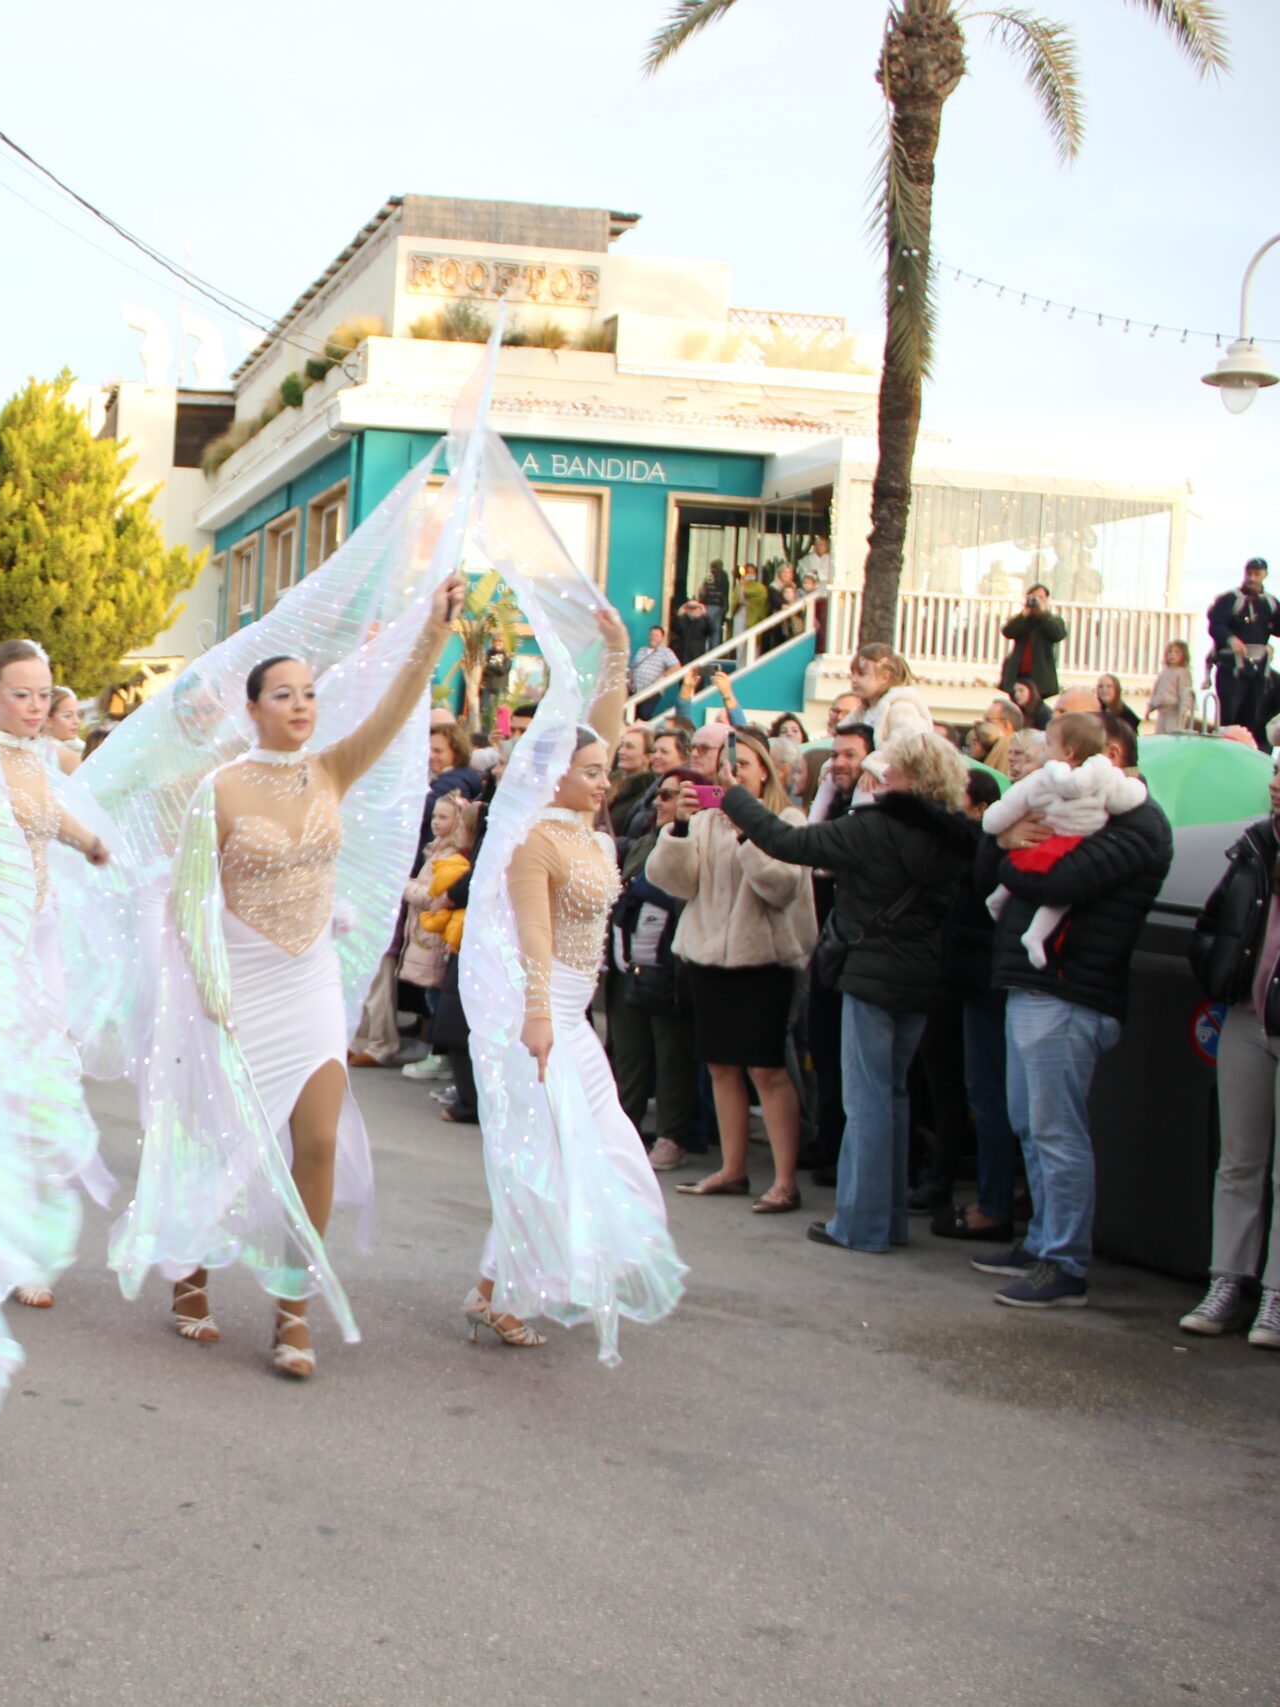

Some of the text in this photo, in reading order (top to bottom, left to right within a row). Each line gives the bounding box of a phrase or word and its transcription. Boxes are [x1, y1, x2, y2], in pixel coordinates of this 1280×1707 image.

[410, 255, 599, 300] ROOFTOP
[520, 453, 666, 482] A BANDIDA
